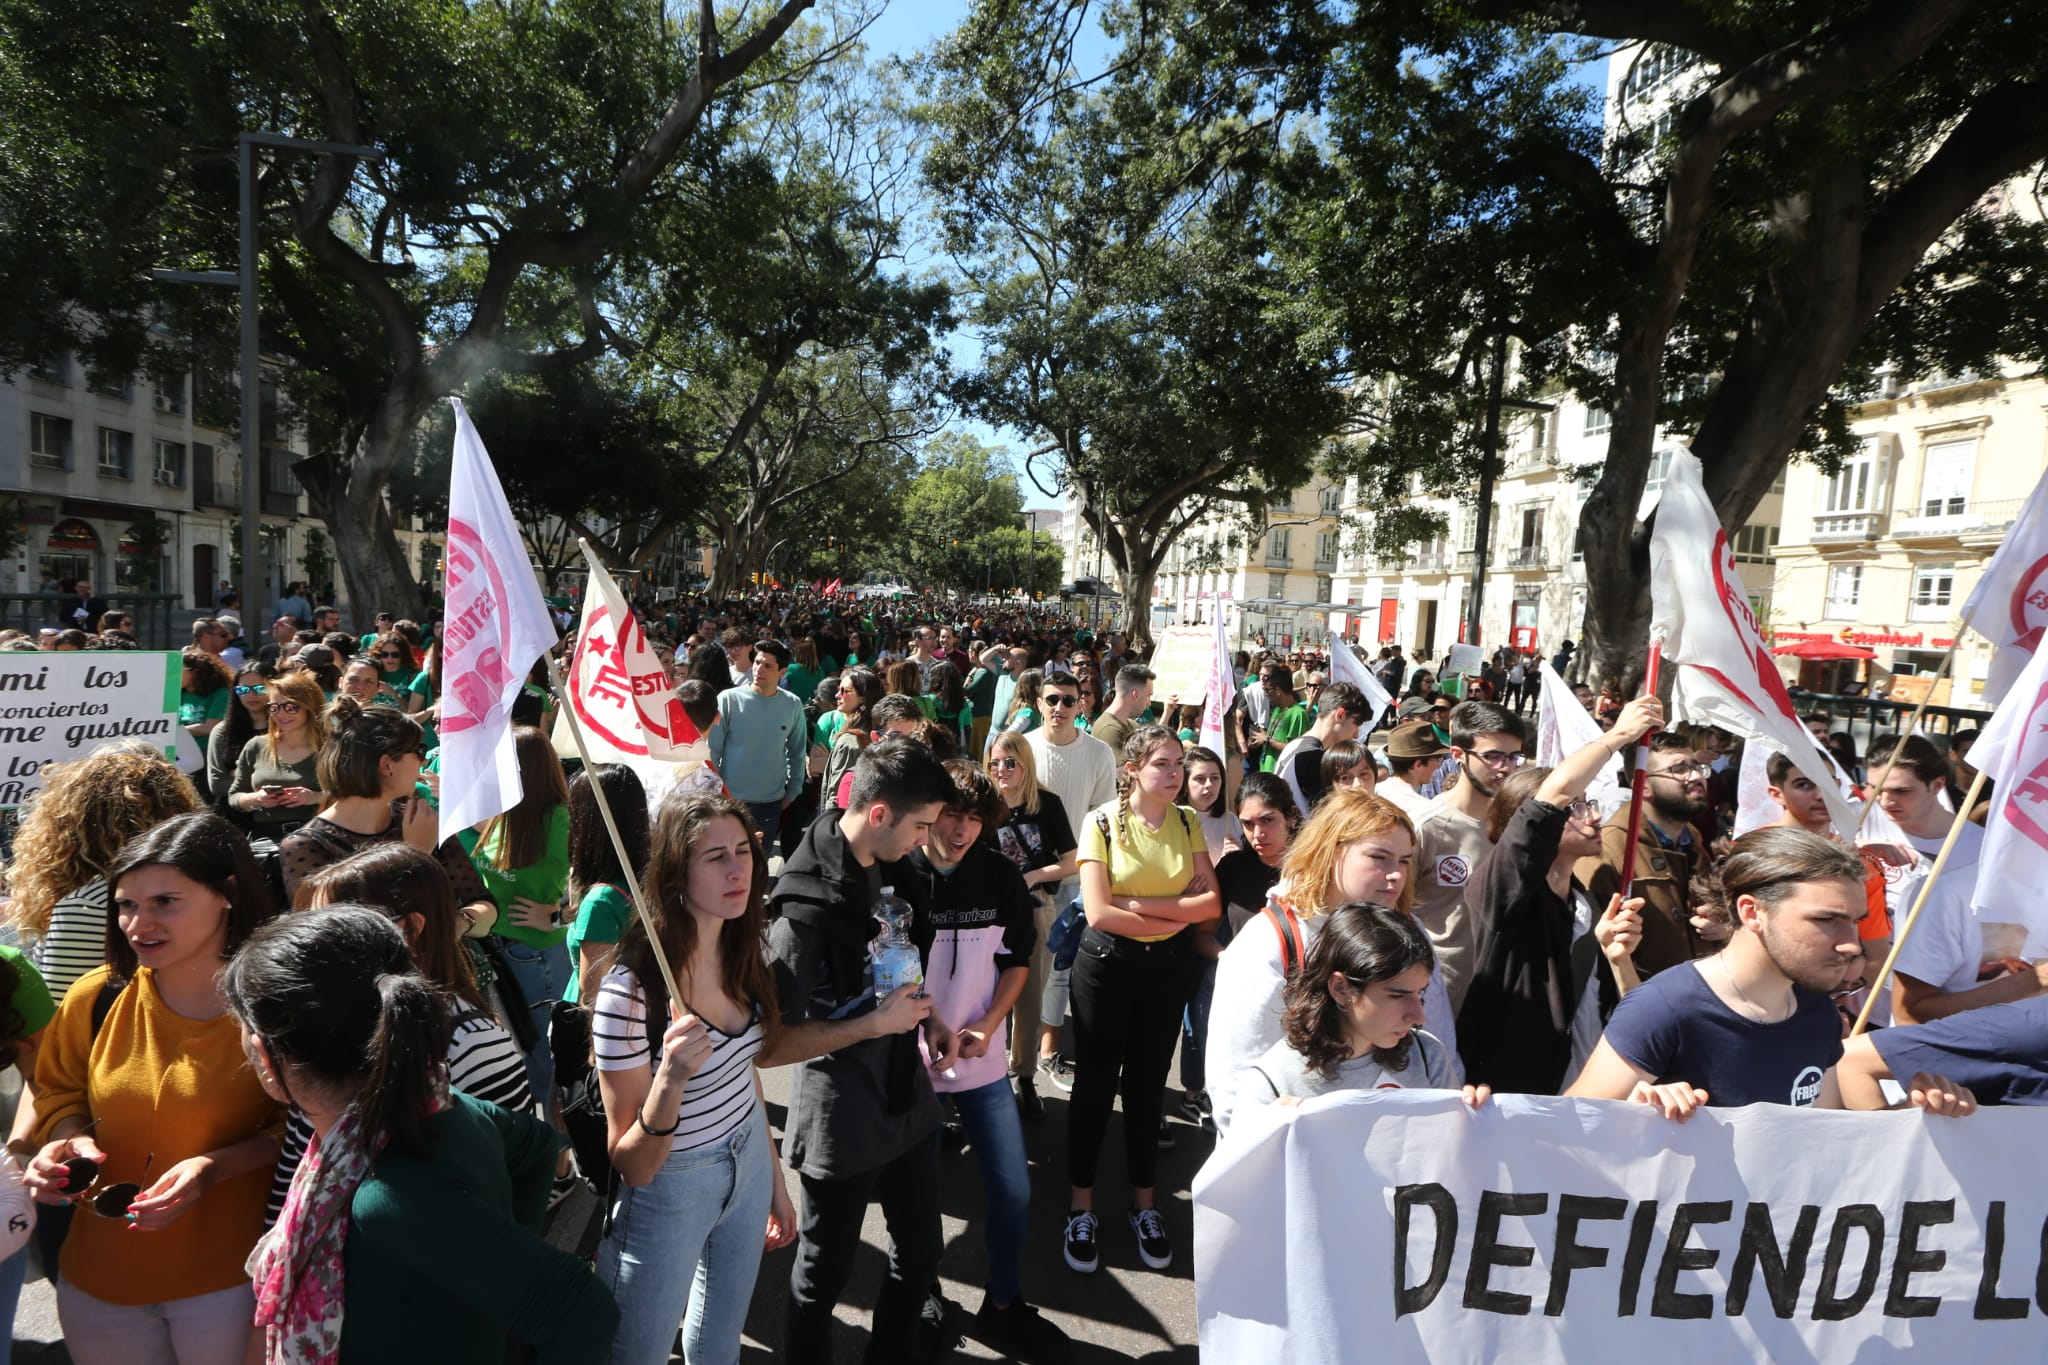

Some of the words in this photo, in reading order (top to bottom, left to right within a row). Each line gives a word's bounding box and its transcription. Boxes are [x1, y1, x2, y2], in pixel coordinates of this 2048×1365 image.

[0, 666, 49, 691] mi
[84, 665, 128, 689] los
[0, 725, 46, 743] me
[65, 717, 169, 748] gustan
